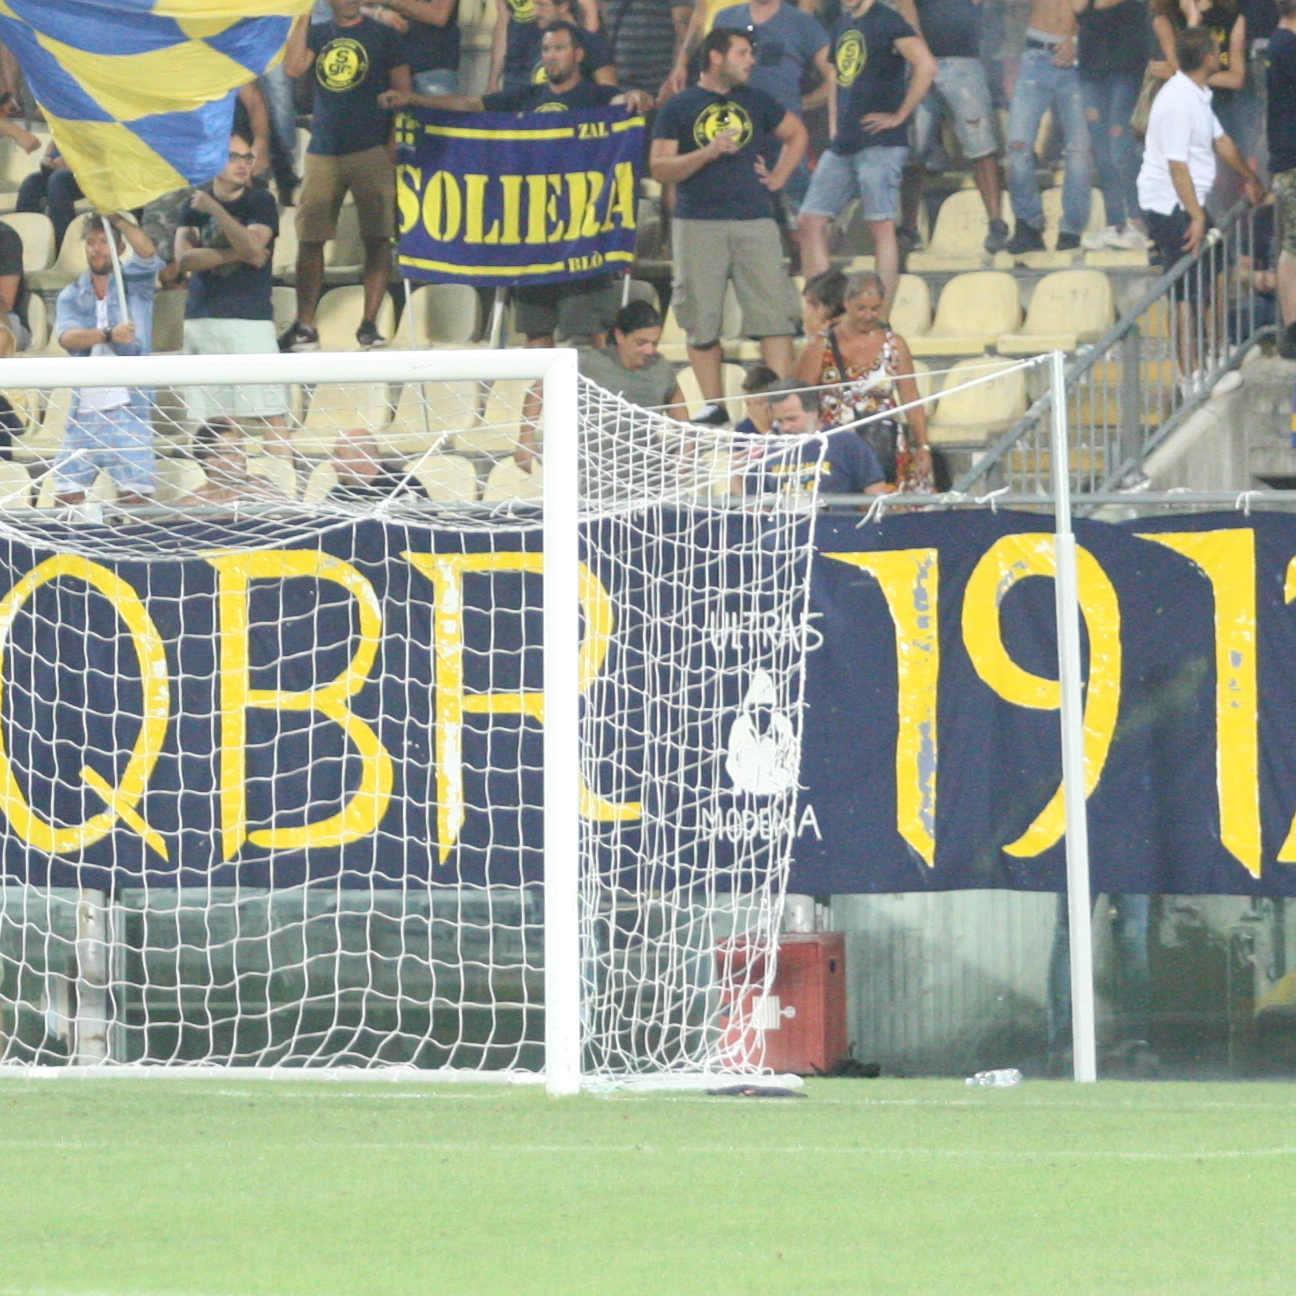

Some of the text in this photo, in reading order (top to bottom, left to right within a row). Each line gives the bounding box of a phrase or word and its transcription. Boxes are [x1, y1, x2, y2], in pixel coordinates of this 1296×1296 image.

[577, 121, 609, 140] ZAL
[395, 160, 637, 245] SOLIERA
[709, 610, 825, 653] ULTRAS
